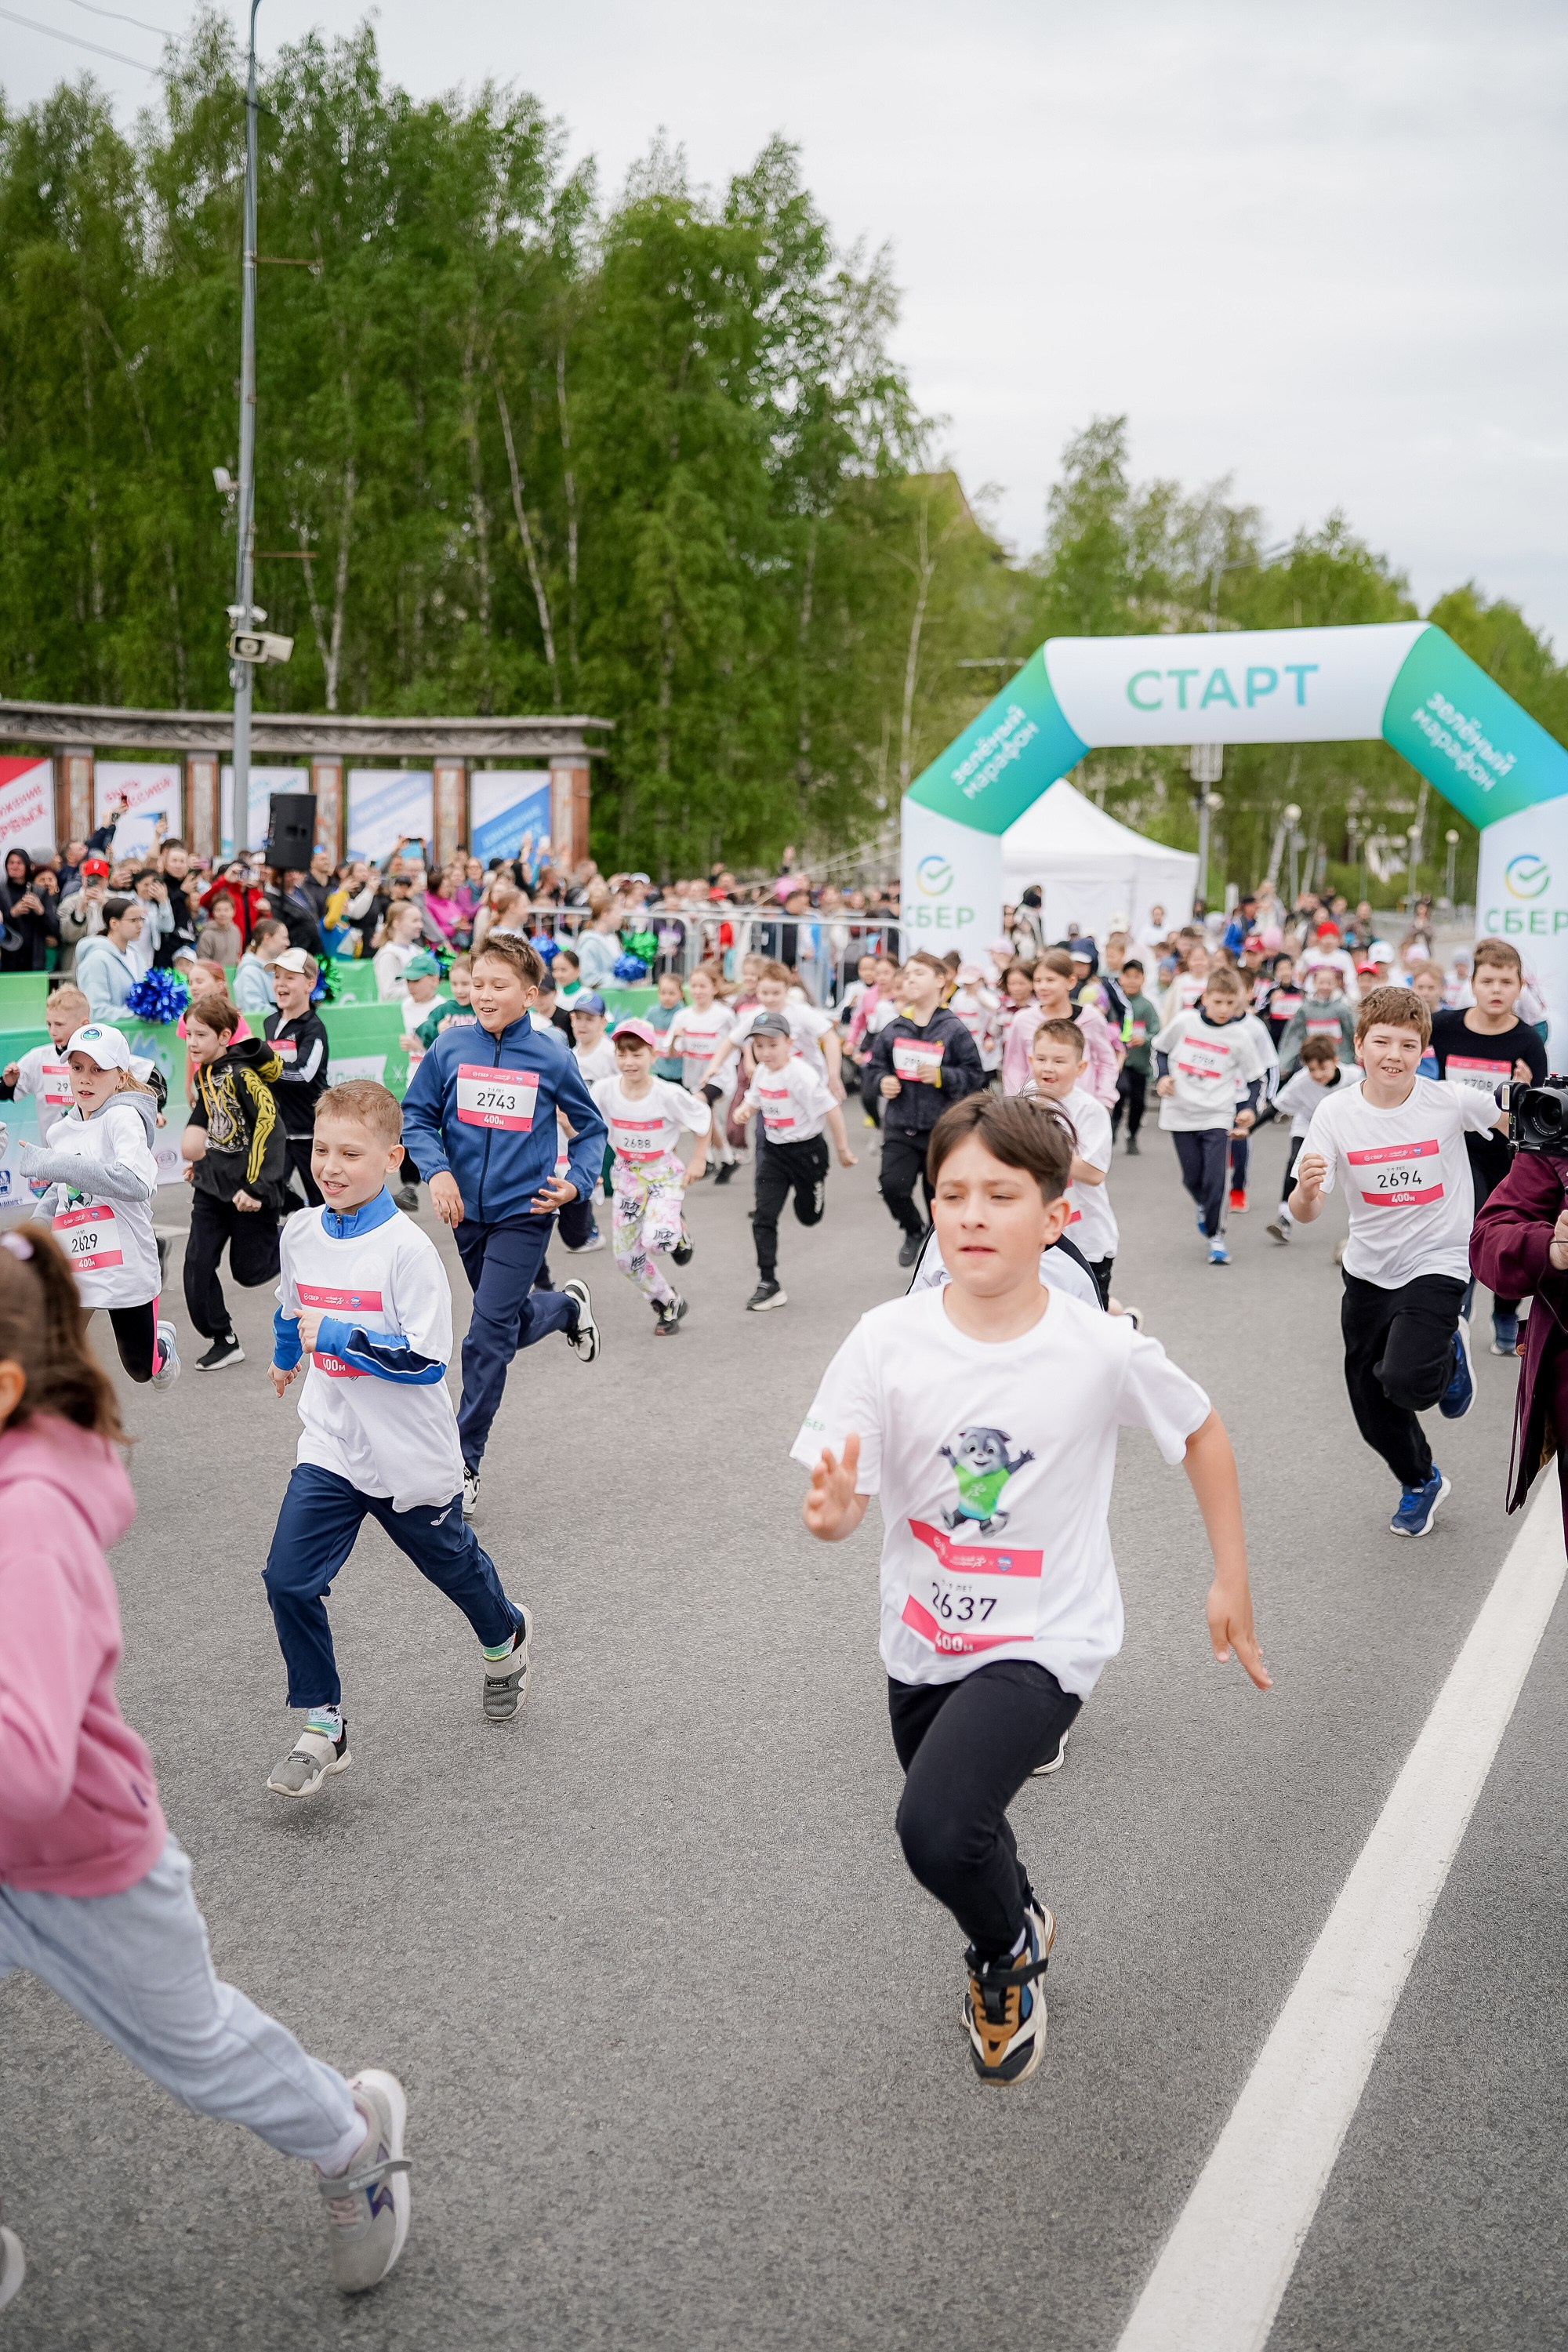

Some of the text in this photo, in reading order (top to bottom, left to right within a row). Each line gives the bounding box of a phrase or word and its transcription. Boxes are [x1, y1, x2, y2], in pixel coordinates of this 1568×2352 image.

[1125, 662, 1319, 712] СТАРТ
[951, 703, 1026, 786] зелёный
[1412, 708, 1497, 793] марафон
[1426, 691, 1518, 777] зелёный
[962, 720, 1040, 800] марафон
[904, 905, 975, 929] СБЕР
[1484, 909, 1568, 935] СБЕР
[477, 1092, 516, 1110] 2743
[624, 1138, 652, 1149] 2688
[1377, 1170, 1423, 1189] 2694
[71, 1233, 98, 1254] 2629
[931, 1581, 998, 1622] 2637
